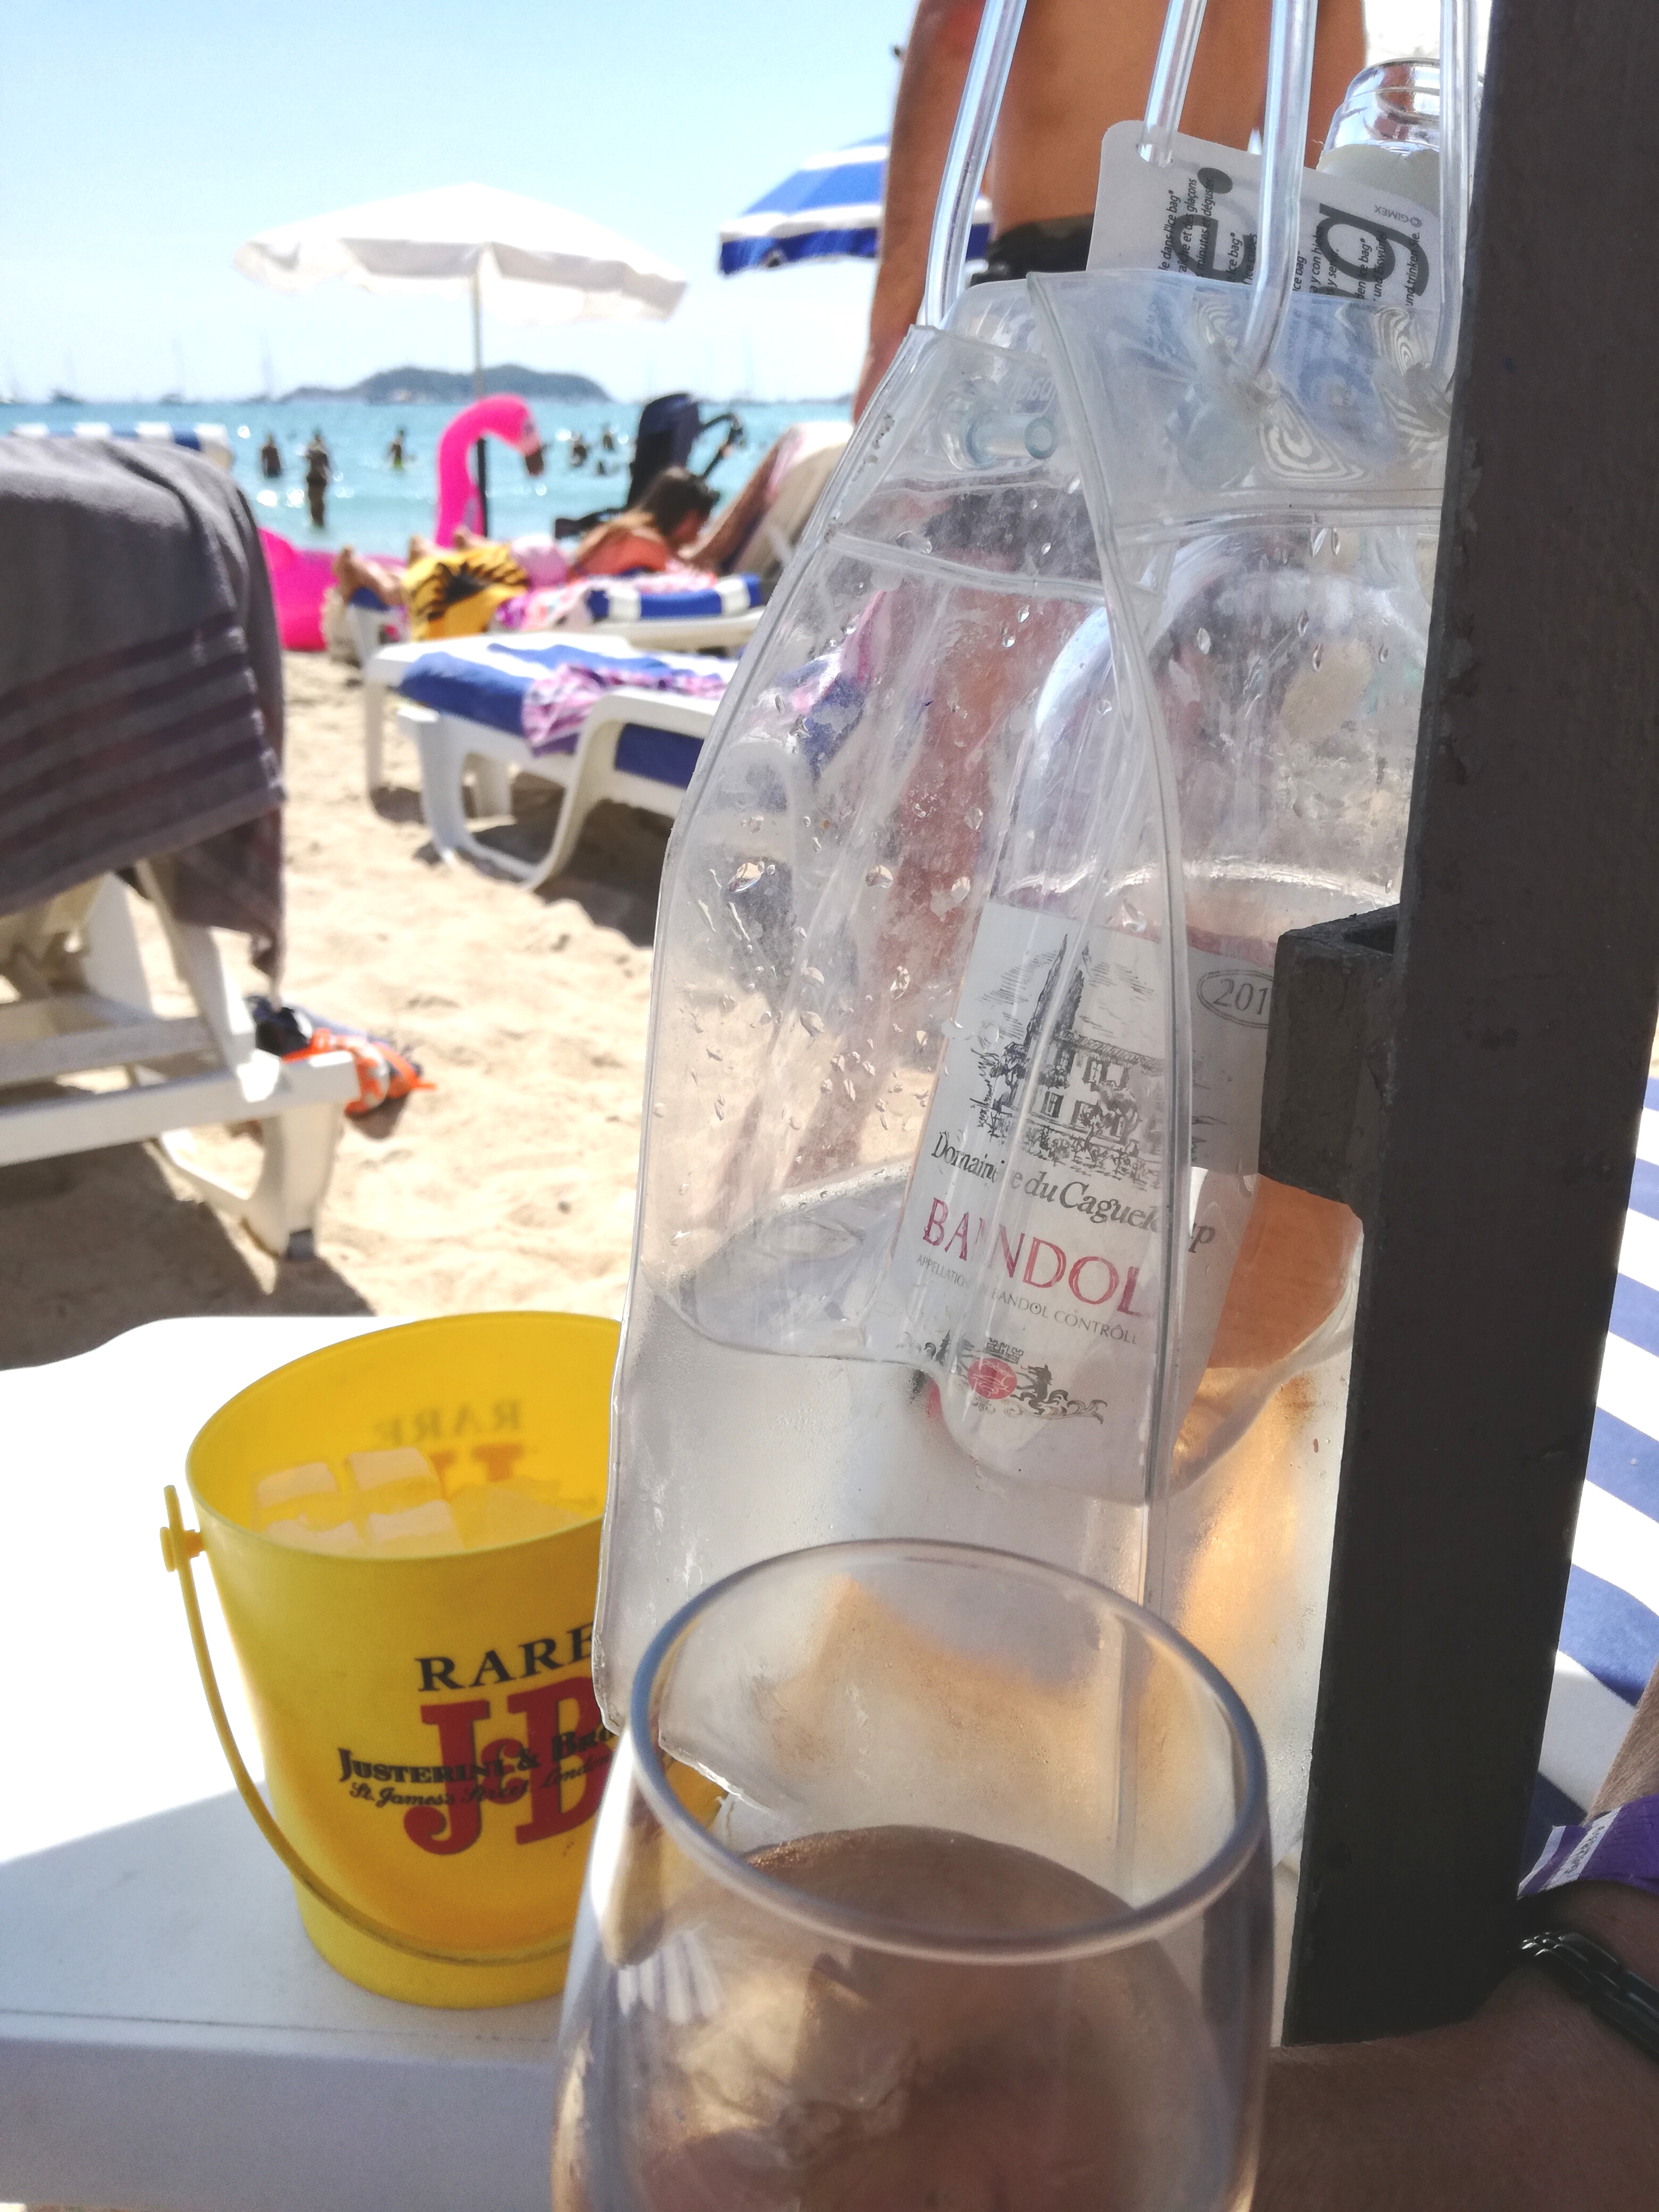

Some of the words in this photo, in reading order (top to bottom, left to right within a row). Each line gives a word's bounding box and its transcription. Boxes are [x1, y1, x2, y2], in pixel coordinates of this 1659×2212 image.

[1185, 179, 1198, 213] glaçons
[1182, 228, 1192, 242] et
[1183, 213, 1194, 231] des
[1161, 234, 1172, 259] dans
[1196, 229, 1210, 271] minutes
[1311, 256, 1320, 276] con
[1406, 250, 1418, 285] trinken
[1213, 978, 1269, 1015] 201
[1025, 1171, 1059, 1203] du
[414, 1621, 593, 1692] RARE
